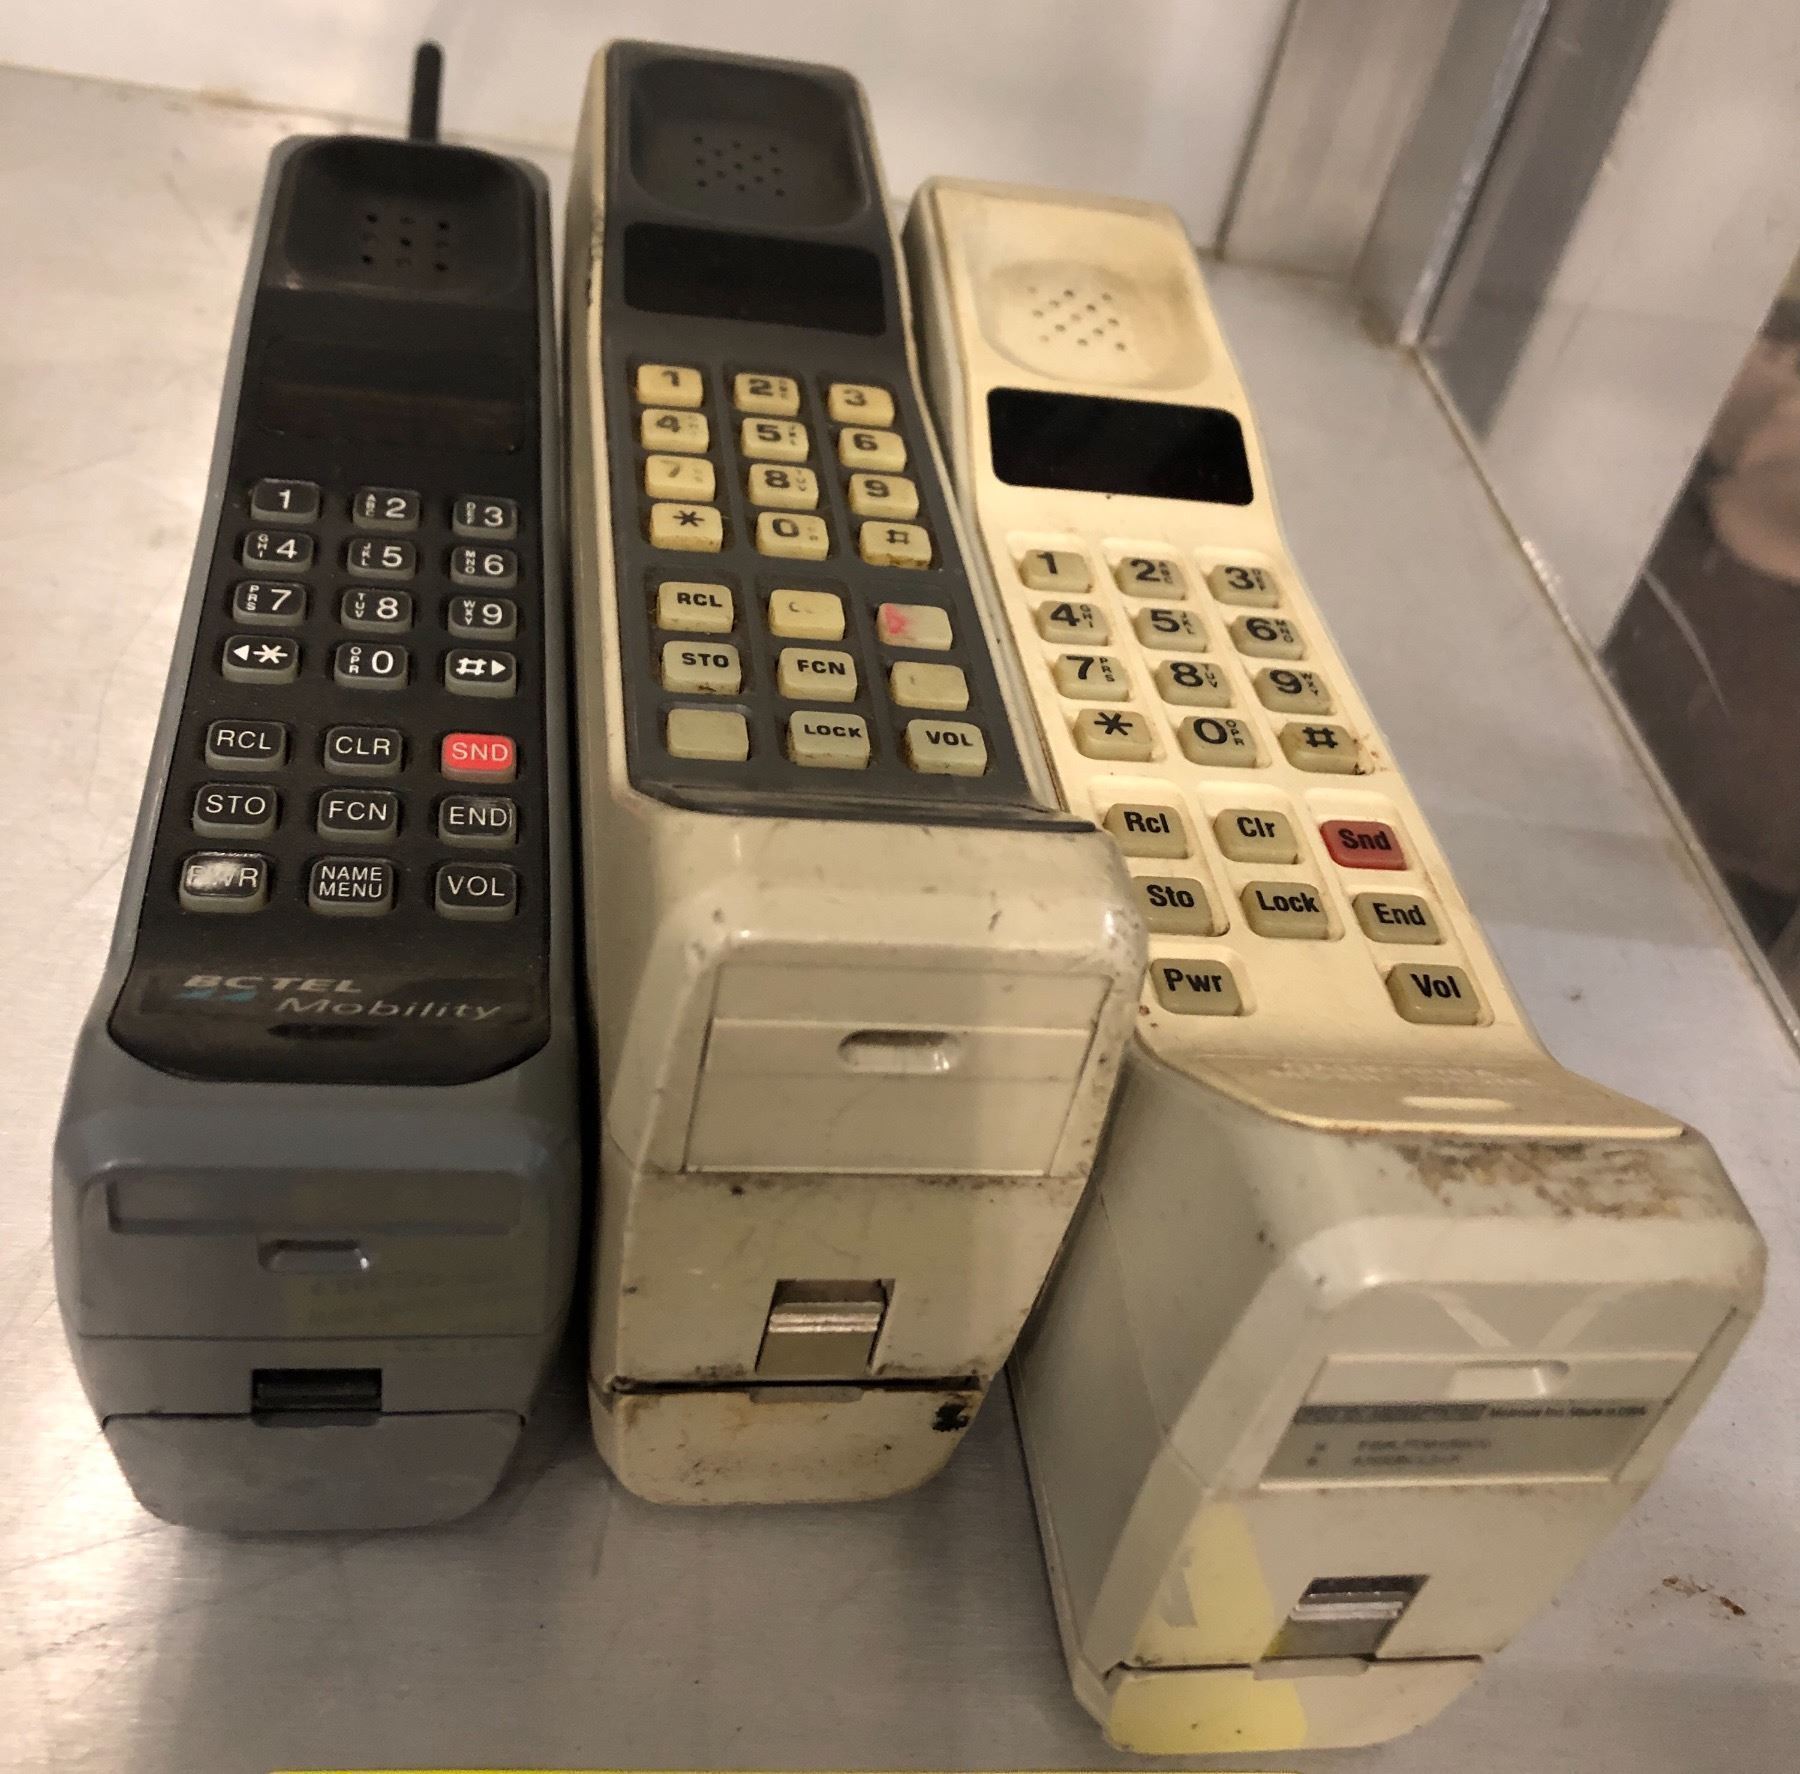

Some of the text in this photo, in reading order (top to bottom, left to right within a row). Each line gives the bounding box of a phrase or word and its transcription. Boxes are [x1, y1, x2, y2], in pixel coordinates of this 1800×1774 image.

[661, 370, 680, 387] 1
[748, 379, 773, 397] 2
[843, 388, 867, 407] 3
[656, 415, 681, 433] 4
[756, 424, 782, 442] 5
[852, 433, 878, 452] 6
[764, 470, 791, 488] 8
[865, 479, 890, 498] 9
[279, 489, 290, 510] 1
[385, 497, 407, 519] 2
[484, 506, 504, 527] 3
[772, 519, 799, 538] 0
[886, 529, 910, 545] #
[276, 538, 298, 559] 4
[381, 545, 403, 568] 5
[484, 553, 504, 576] 6
[1036, 551, 1059, 575] 1
[1130, 558, 1161, 583] 2
[1224, 566, 1255, 590] 3
[271, 588, 292, 611] 7
[376, 597, 399, 620] 8
[676, 592, 723, 609] RCL
[482, 603, 503, 626] 9
[1050, 603, 1081, 627] 4
[1150, 608, 1181, 633] 5
[1245, 617, 1278, 642] 6
[371, 650, 394, 674] 0
[456, 657, 487, 676] #
[681, 651, 730, 669] STO
[796, 658, 846, 676] FCN
[1066, 655, 1095, 680] 7
[1169, 661, 1204, 688] 8
[1269, 668, 1303, 694] 9
[216, 729, 272, 750] RCL
[803, 723, 863, 739] LOCK
[925, 729, 975, 748] VOL
[1193, 717, 1228, 745] 0
[1302, 726, 1339, 749] #
[335, 735, 391, 756] CLR
[451, 742, 509, 762] SND
[205, 794, 266, 815] STO
[328, 800, 387, 821] FCN
[449, 806, 508, 827] END
[1123, 811, 1170, 834] Rcl
[1236, 815, 1276, 839] Clr
[1337, 828, 1392, 851] Snd
[321, 865, 382, 882] NAME
[318, 881, 383, 898] MENU
[447, 874, 505, 897] VOL
[1146, 884, 1195, 909] Sto
[1255, 889, 1320, 914] Lock
[1372, 903, 1427, 927] End
[1162, 968, 1223, 993] Pwr
[1410, 973, 1462, 999] Vol
[274, 997, 502, 1021] Mobility
